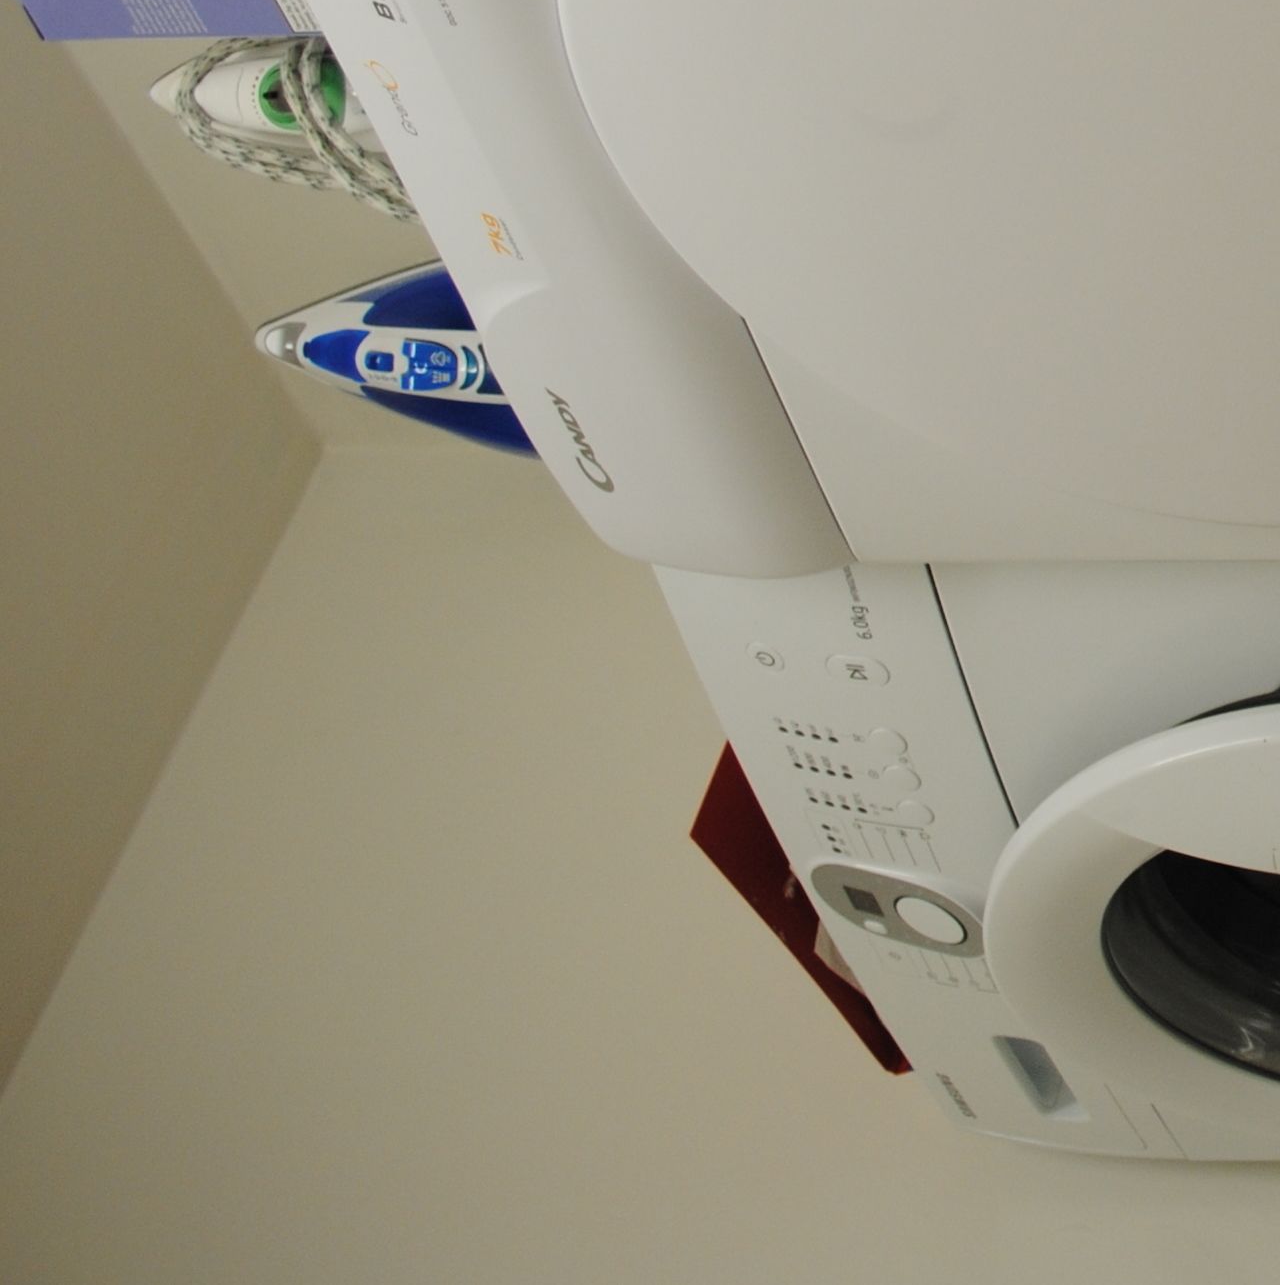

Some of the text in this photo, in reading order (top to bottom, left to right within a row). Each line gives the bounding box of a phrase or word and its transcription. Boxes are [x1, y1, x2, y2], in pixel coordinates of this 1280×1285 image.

[372, 0, 396, 21] B
[480, 212, 512, 255] 7kg
[545, 387, 615, 493] CANDY
[851, 605, 874, 640] 6.0kg
